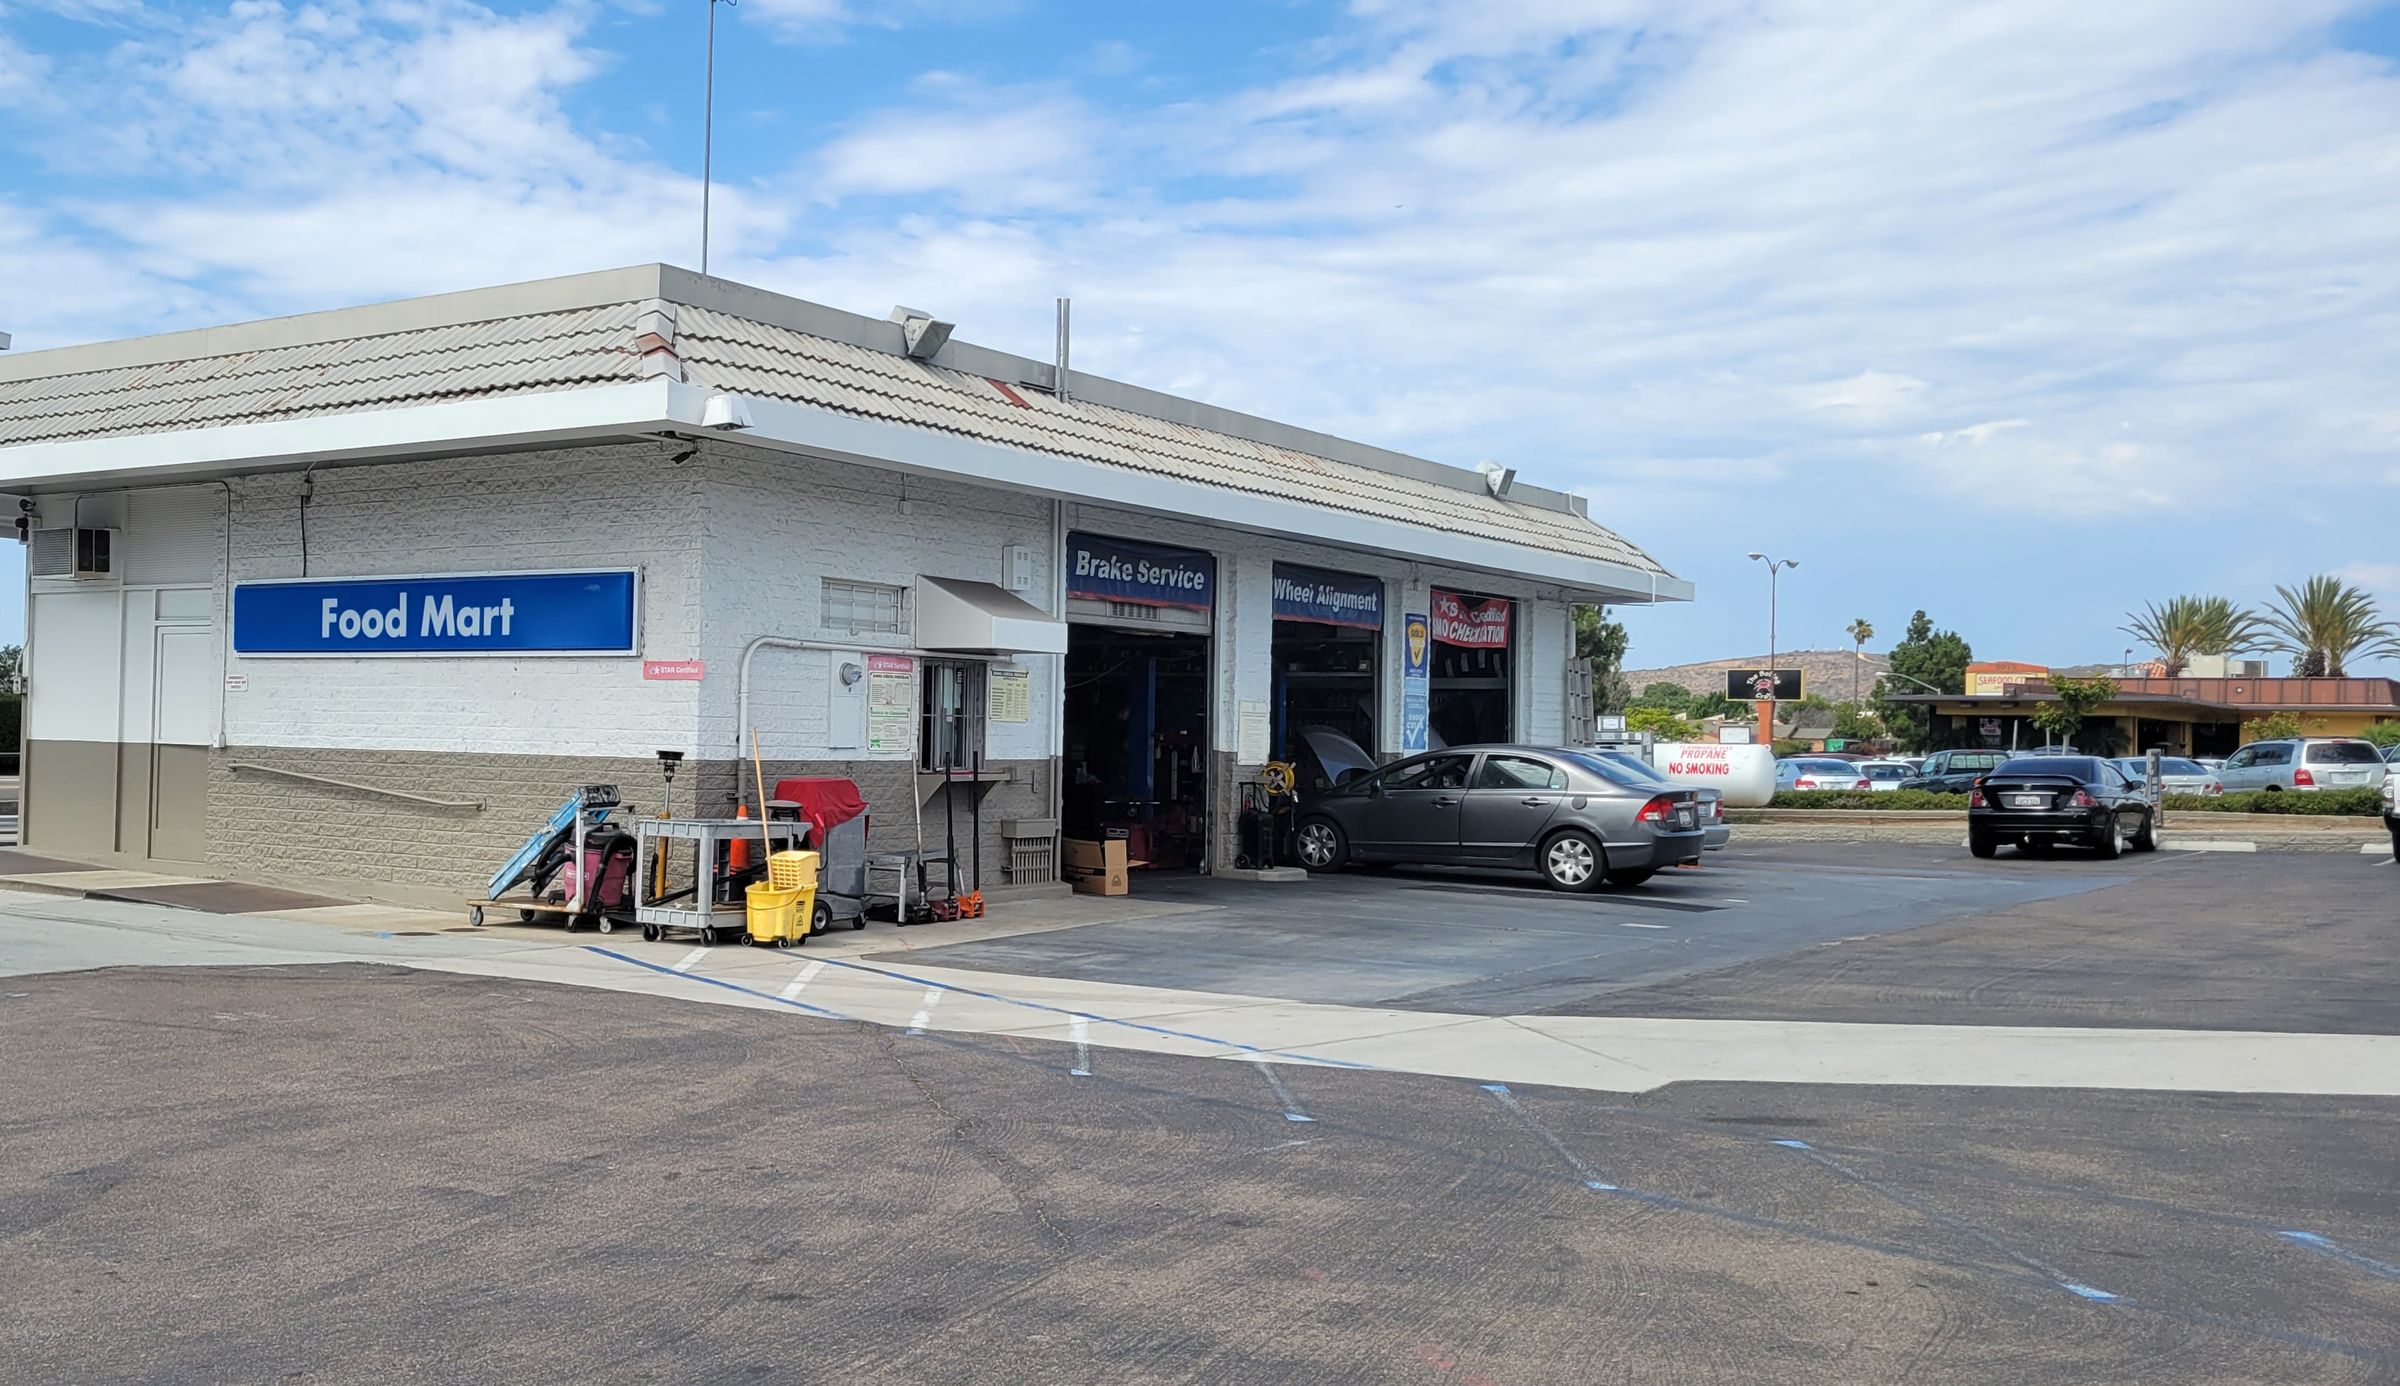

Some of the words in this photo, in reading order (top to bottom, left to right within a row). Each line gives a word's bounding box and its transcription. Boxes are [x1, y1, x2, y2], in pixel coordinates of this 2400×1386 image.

[1075, 549, 1133, 582] Brake
[1137, 559, 1205, 590] Service
[1274, 578, 1314, 604] Wheel
[1316, 584, 1378, 613] Alignment
[321, 592, 408, 639] Food
[420, 594, 515, 637] Mart
[660, 666, 675, 674] STAR
[1680, 749, 1728, 759] PROPANE
[1669, 763, 1683, 775] NO
[1685, 763, 1729, 775] SMOKING
